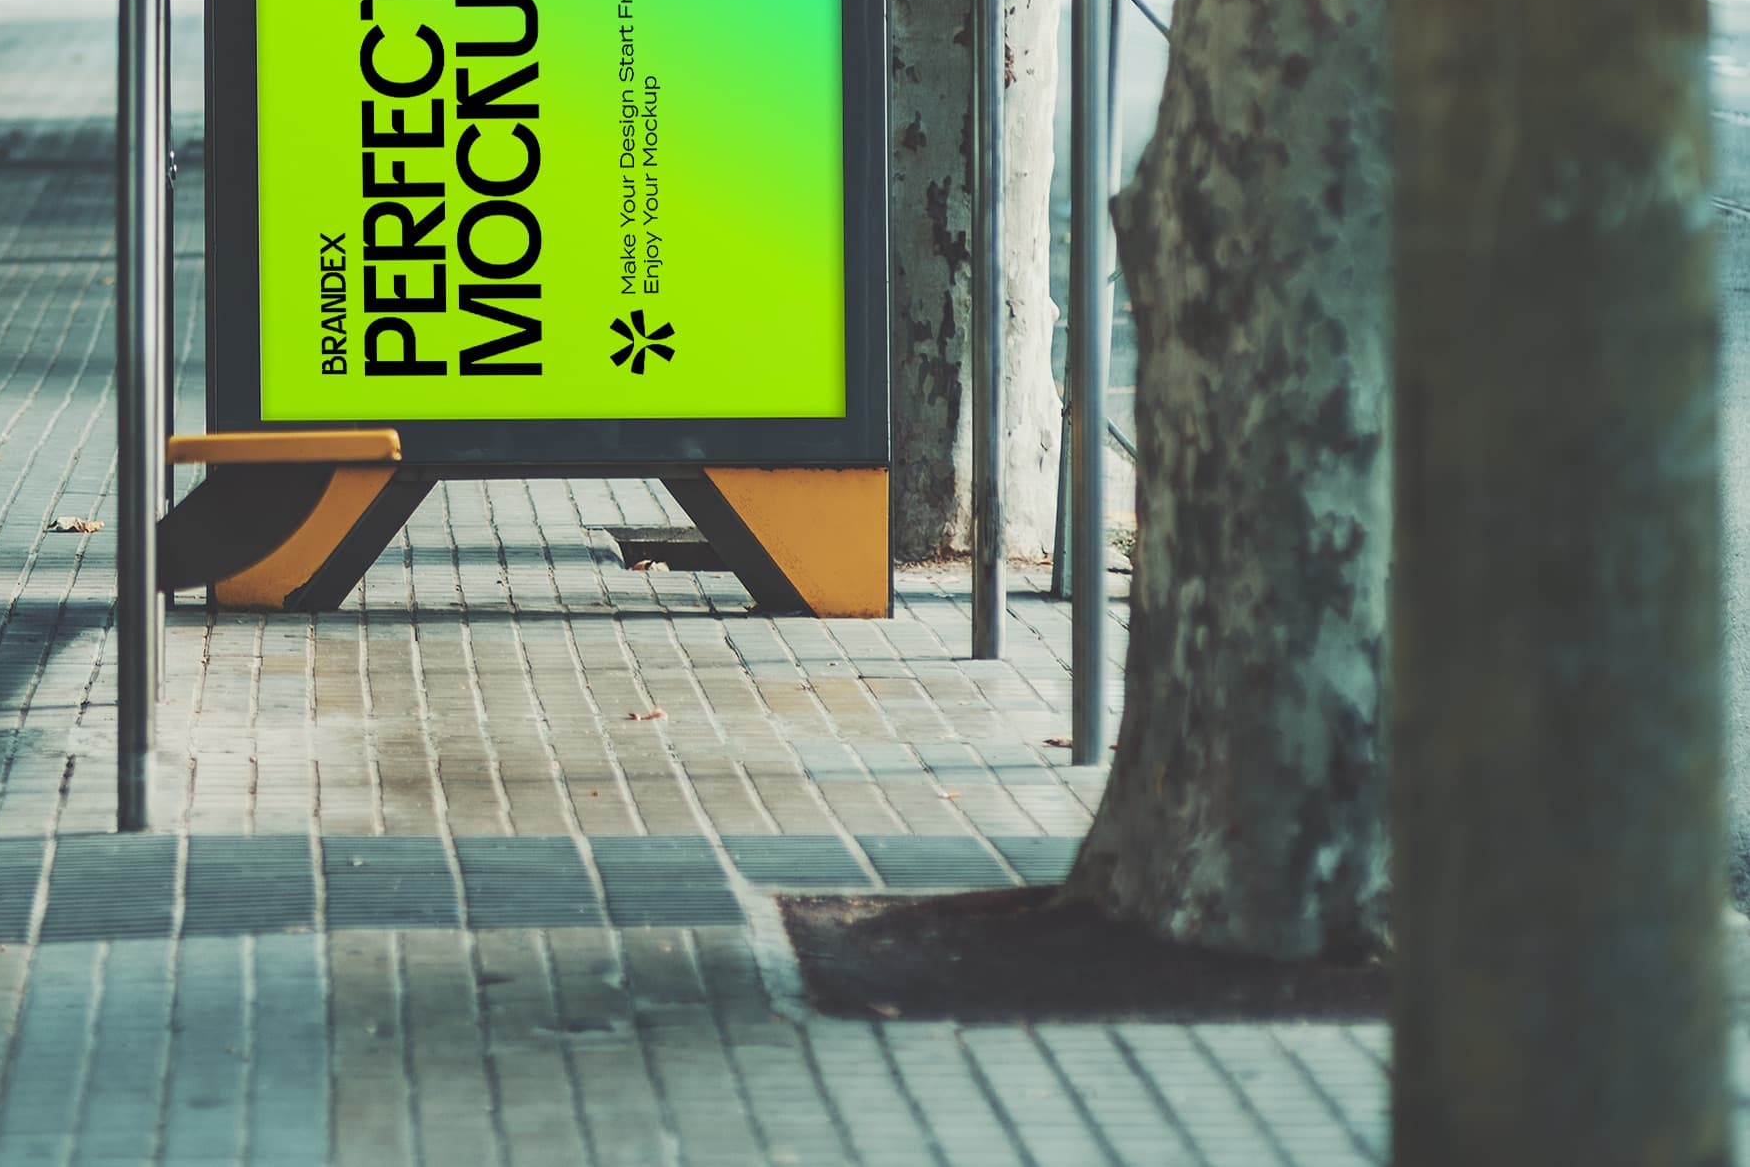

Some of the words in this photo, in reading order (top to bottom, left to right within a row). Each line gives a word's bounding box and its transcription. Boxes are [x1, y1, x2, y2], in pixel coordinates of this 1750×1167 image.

[618, 25, 635, 83] Start
[619, 90, 639, 170] Design
[642, 76, 662, 168] Mockup
[619, 175, 636, 228] Your
[642, 173, 659, 227] Your
[620, 234, 637, 295] Make
[643, 231, 663, 295] Enjoy
[319, 232, 348, 376] BRANDEX
